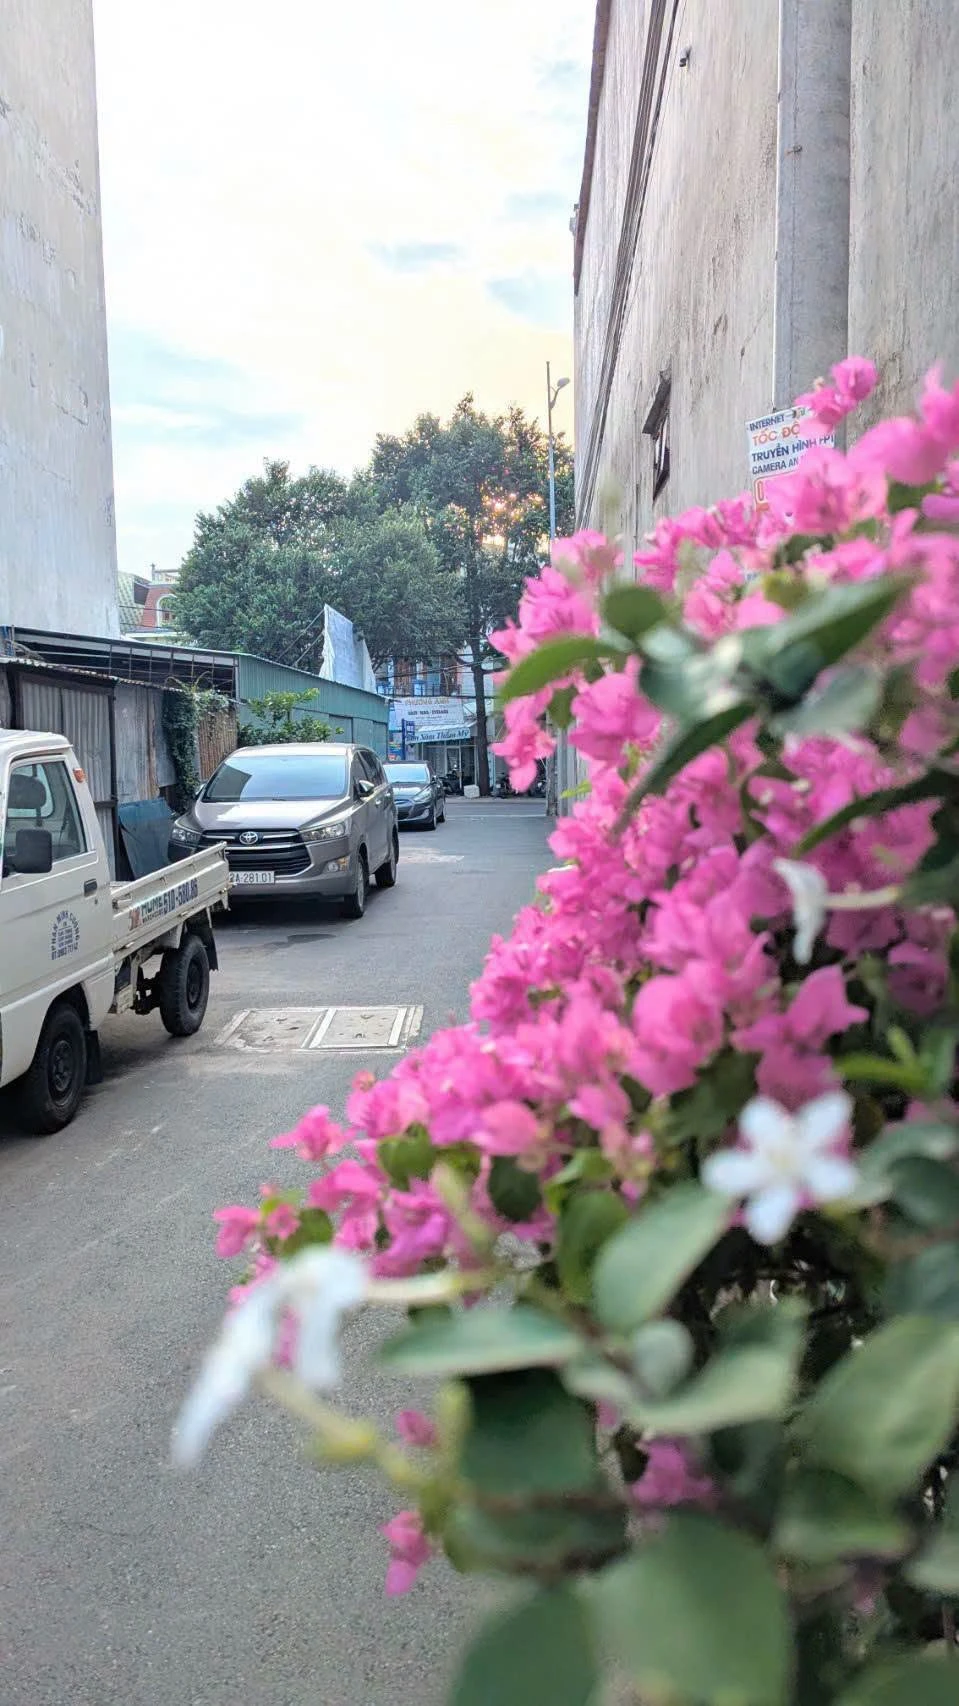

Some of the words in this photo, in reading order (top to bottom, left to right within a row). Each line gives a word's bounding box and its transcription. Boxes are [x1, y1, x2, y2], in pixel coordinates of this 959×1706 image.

[749, 414, 785, 432] INTERNET
[752, 428, 777, 446] TỐC
[751, 442, 789, 462] TRUYỀN
[752, 461, 786, 475] CAMERA
[228, 871, 272, 883] 2A-281.01
